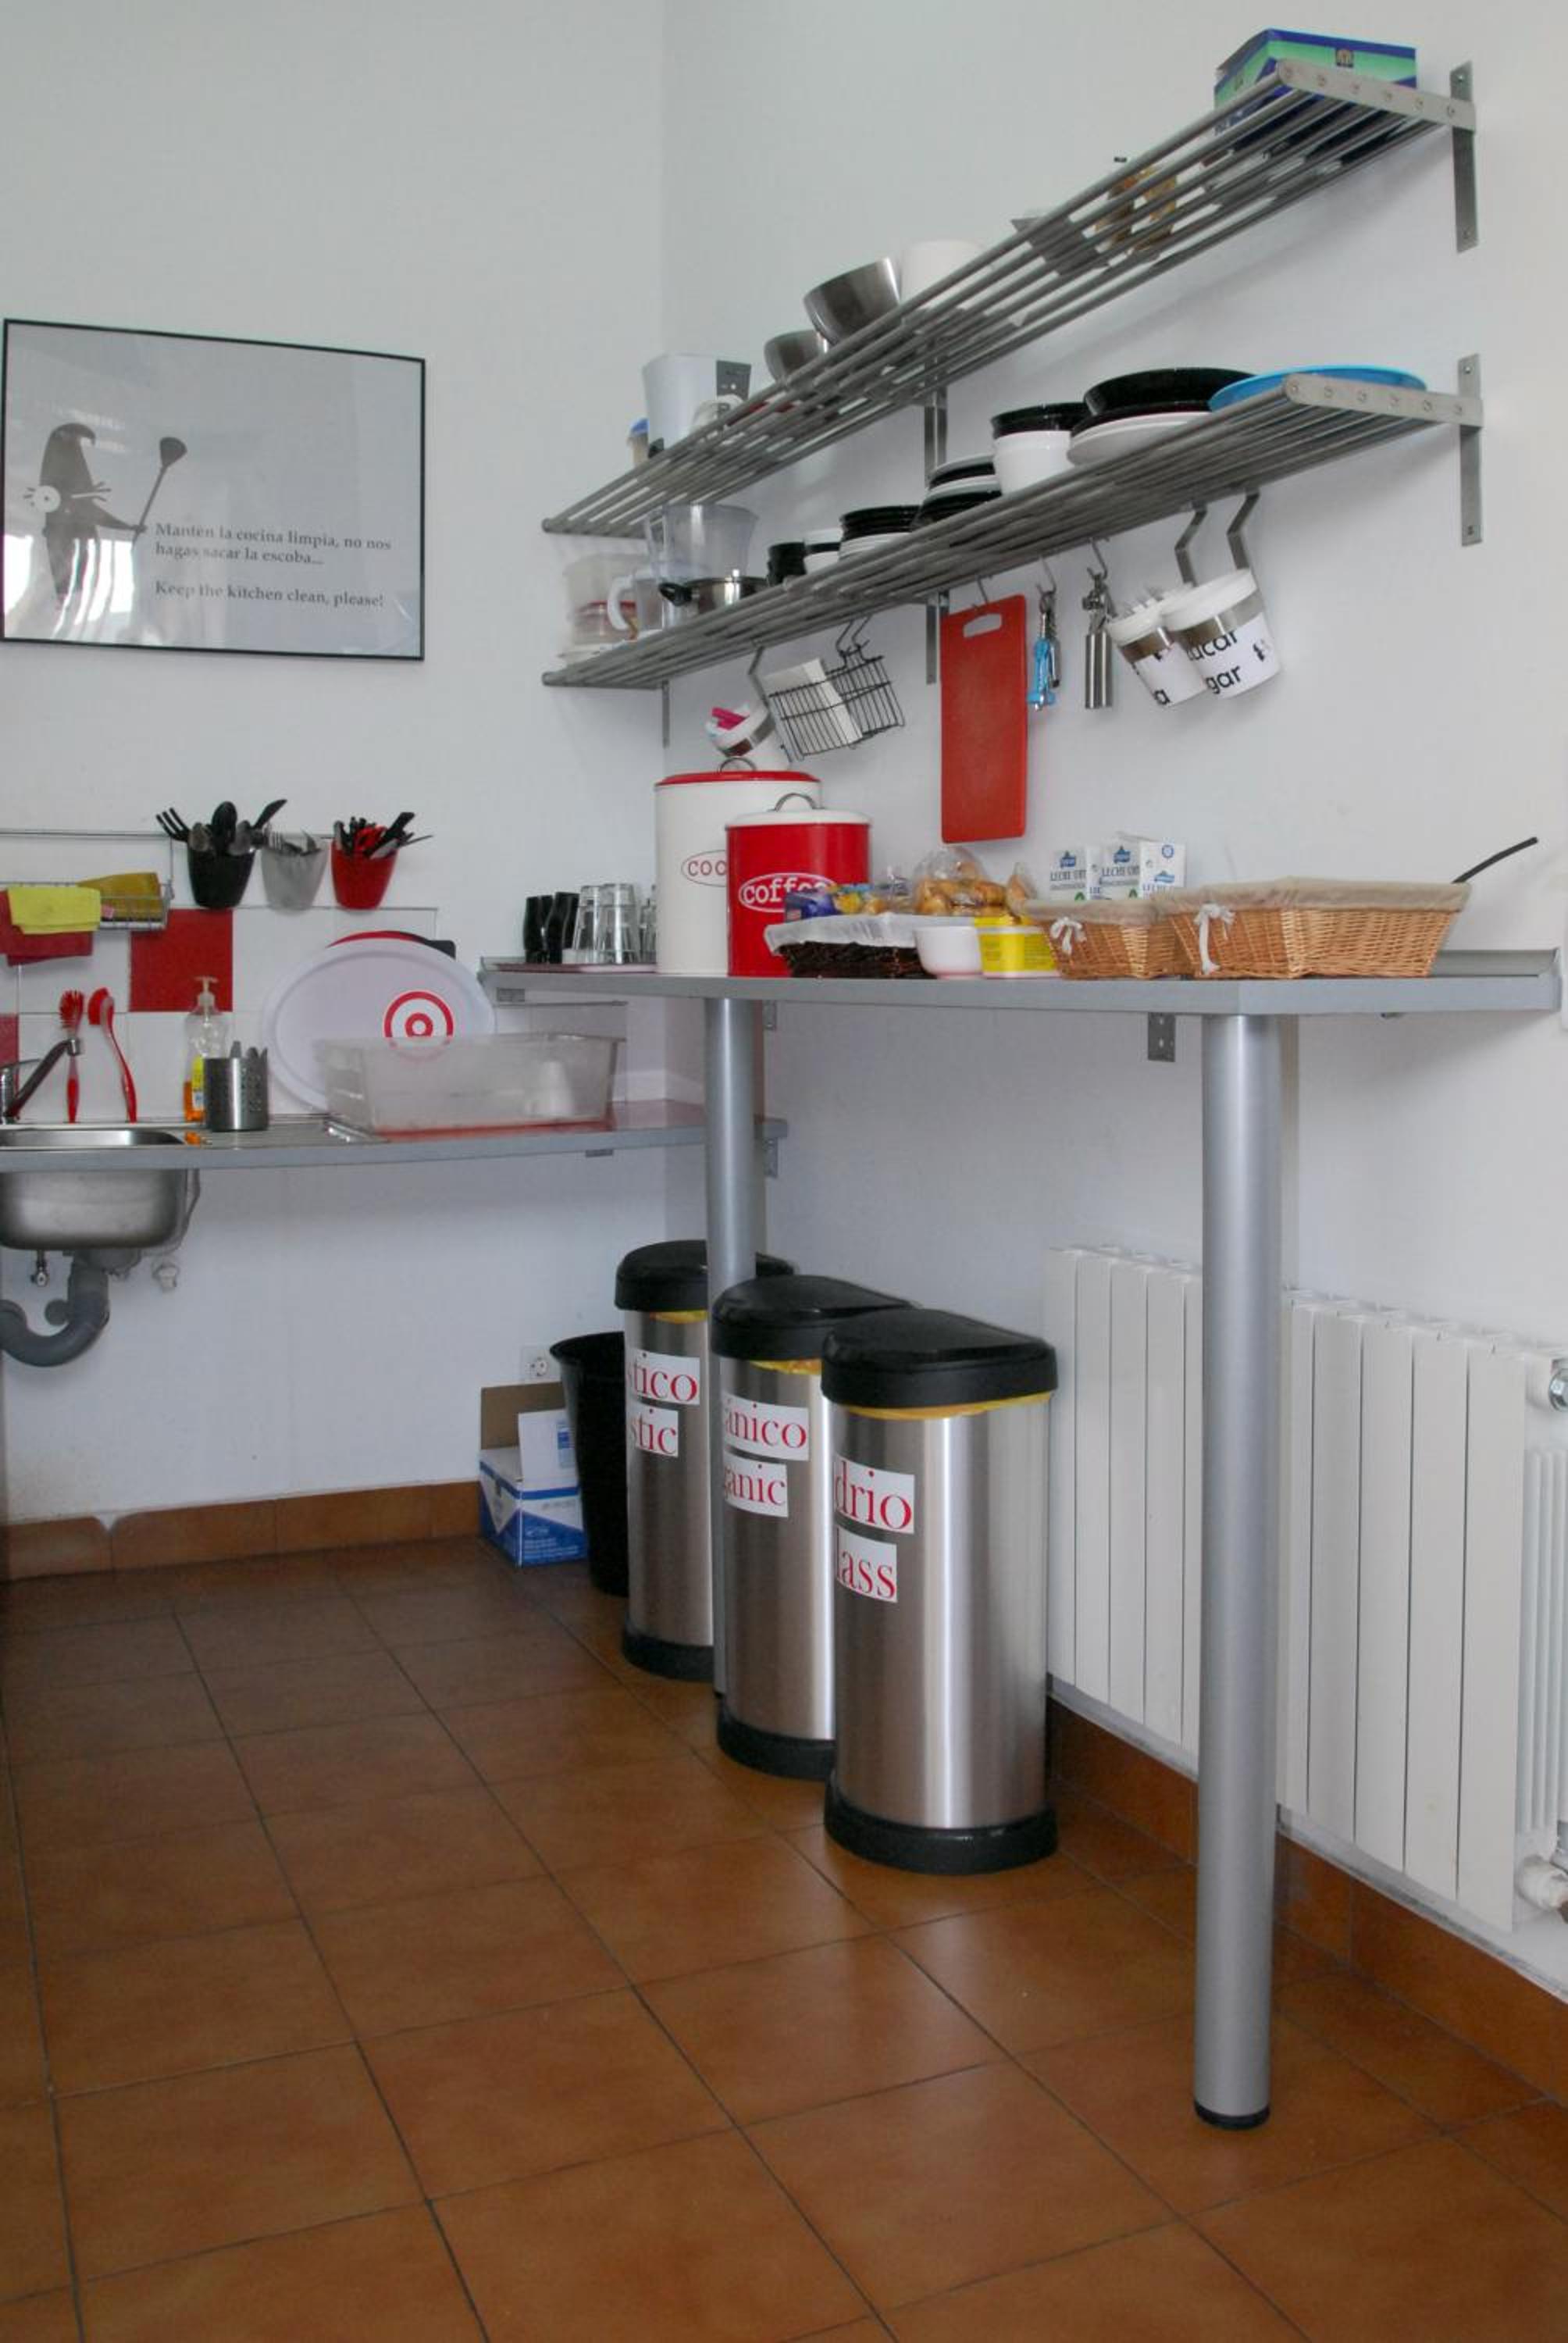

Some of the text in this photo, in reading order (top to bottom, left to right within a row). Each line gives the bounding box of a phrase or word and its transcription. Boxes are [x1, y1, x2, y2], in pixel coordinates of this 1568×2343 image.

[219, 524, 232, 538] la
[237, 528, 283, 543] cocina
[288, 530, 339, 549] limpia,
[344, 537, 362, 548] no
[366, 539, 391, 550] nos
[156, 541, 325, 565] hagas sacar la escoba...
[156, 581, 383, 608] Keep the kitchen clean, please!
[835, 1460, 913, 1530] drio
